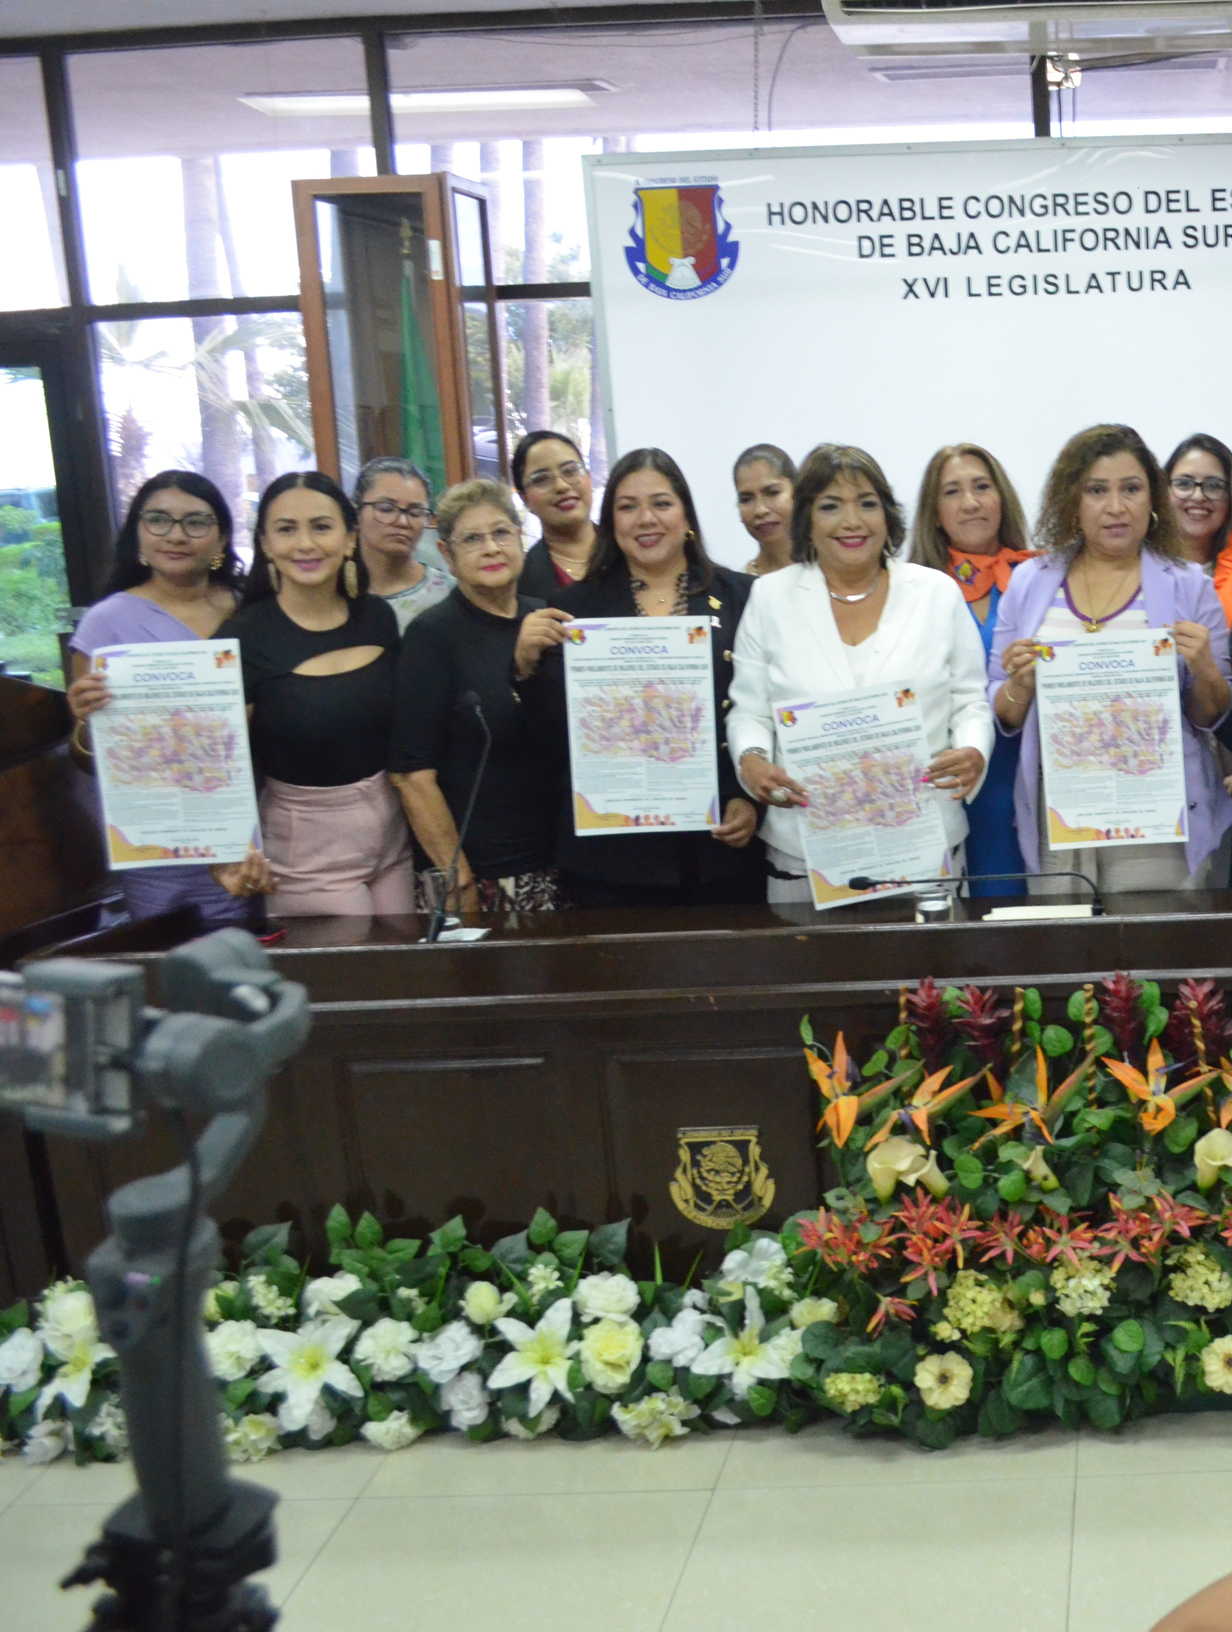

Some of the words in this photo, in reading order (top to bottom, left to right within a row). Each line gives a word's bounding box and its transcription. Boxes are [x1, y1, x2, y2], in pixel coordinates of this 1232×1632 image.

[766, 196, 956, 227] HONORABLE
[962, 190, 1134, 220] CONGRESO
[1143, 189, 1201, 215] DEL
[856, 233, 897, 260] DE
[905, 231, 984, 258] BAJA
[991, 225, 1173, 255] CALIFORNIA
[900, 276, 950, 301] XVI
[965, 268, 1193, 299] LEGISLATURA
[609, 645, 670, 656] CONVOCA
[1079, 659, 1136, 671] CONVOCA
[133, 671, 197, 683] CONVOCA
[822, 714, 880, 732] CONVOCA
